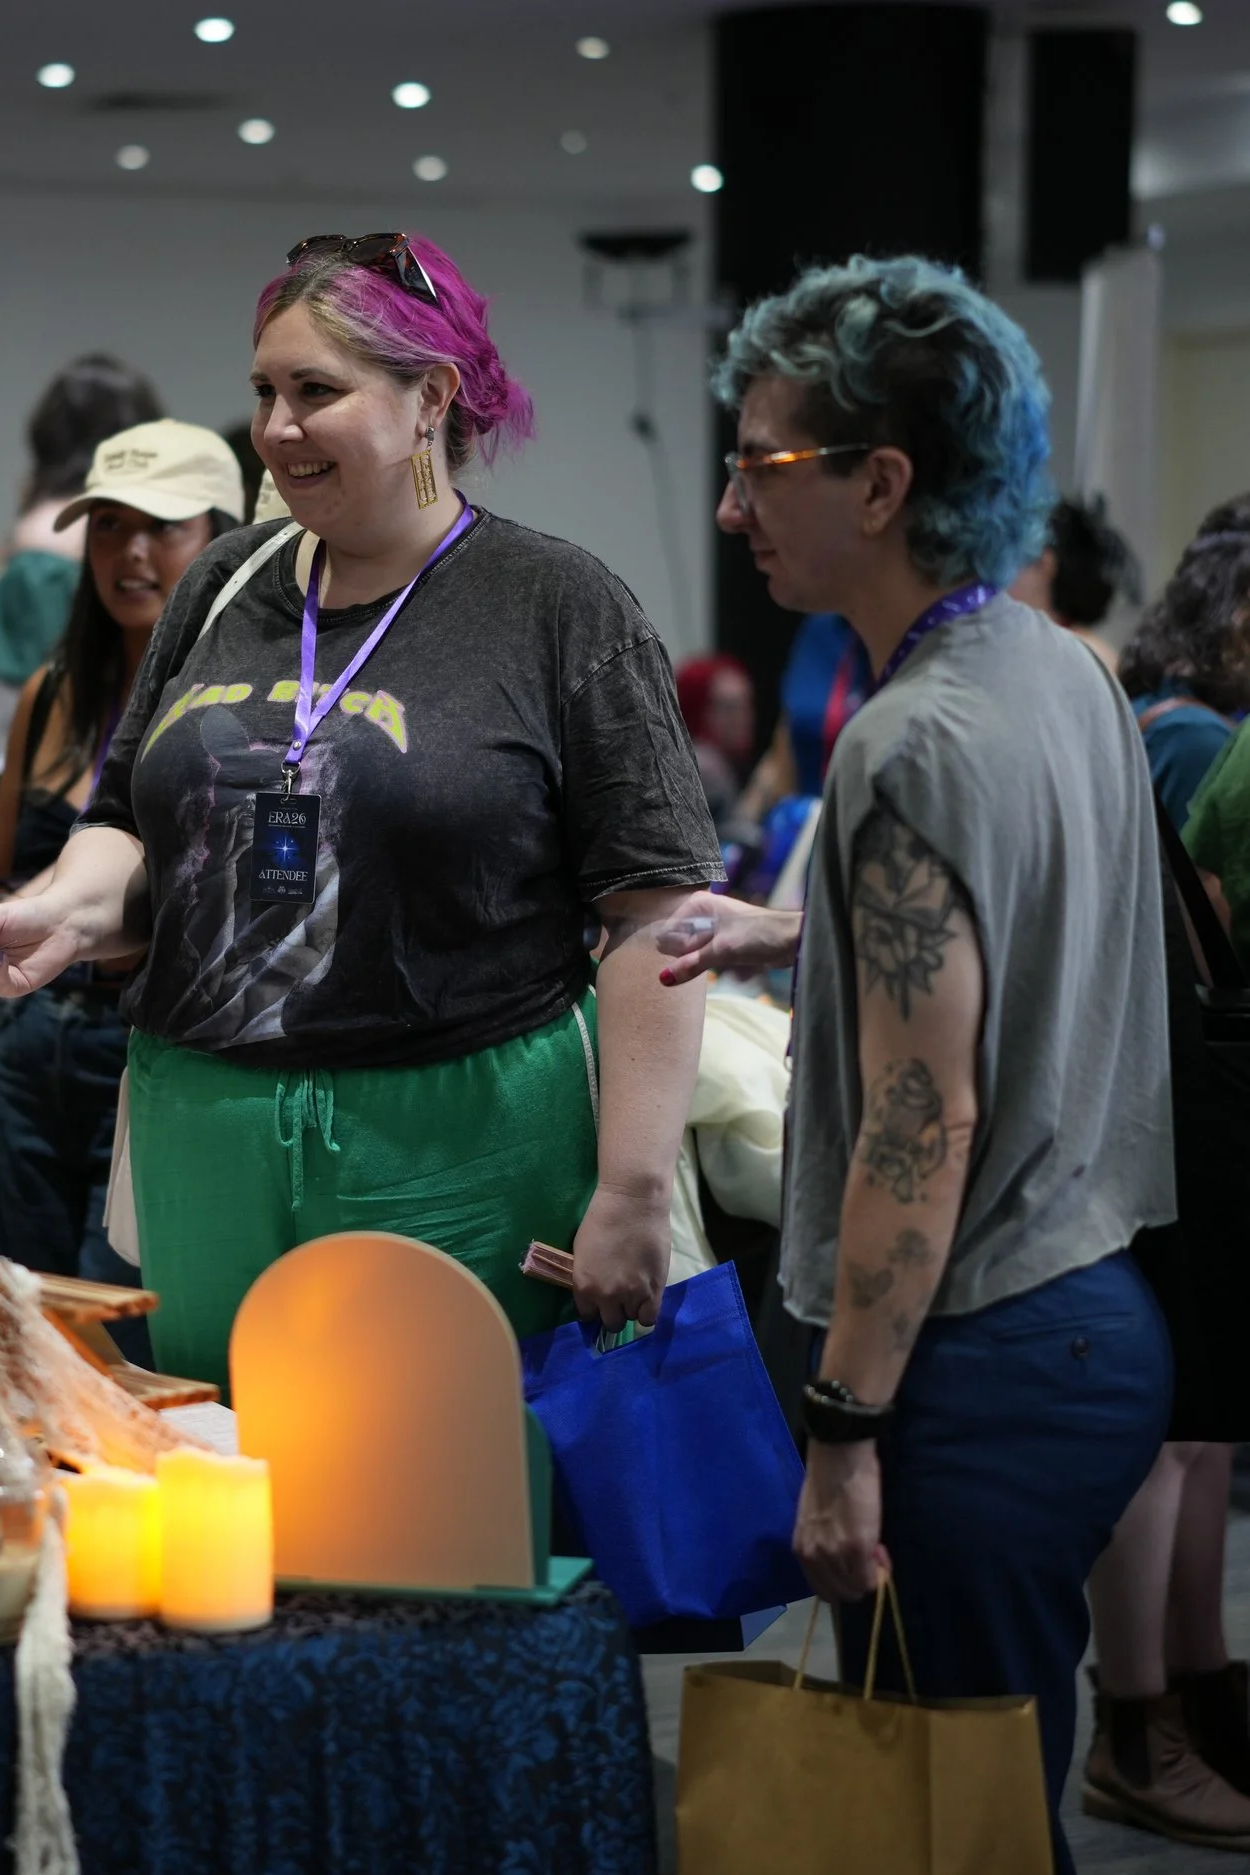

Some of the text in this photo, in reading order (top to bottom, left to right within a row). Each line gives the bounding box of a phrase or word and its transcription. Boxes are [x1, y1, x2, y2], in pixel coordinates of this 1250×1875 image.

[267, 680, 407, 753] BCH
[268, 811, 307, 825] ERA26
[258, 869, 308, 882] ATTENDEE
